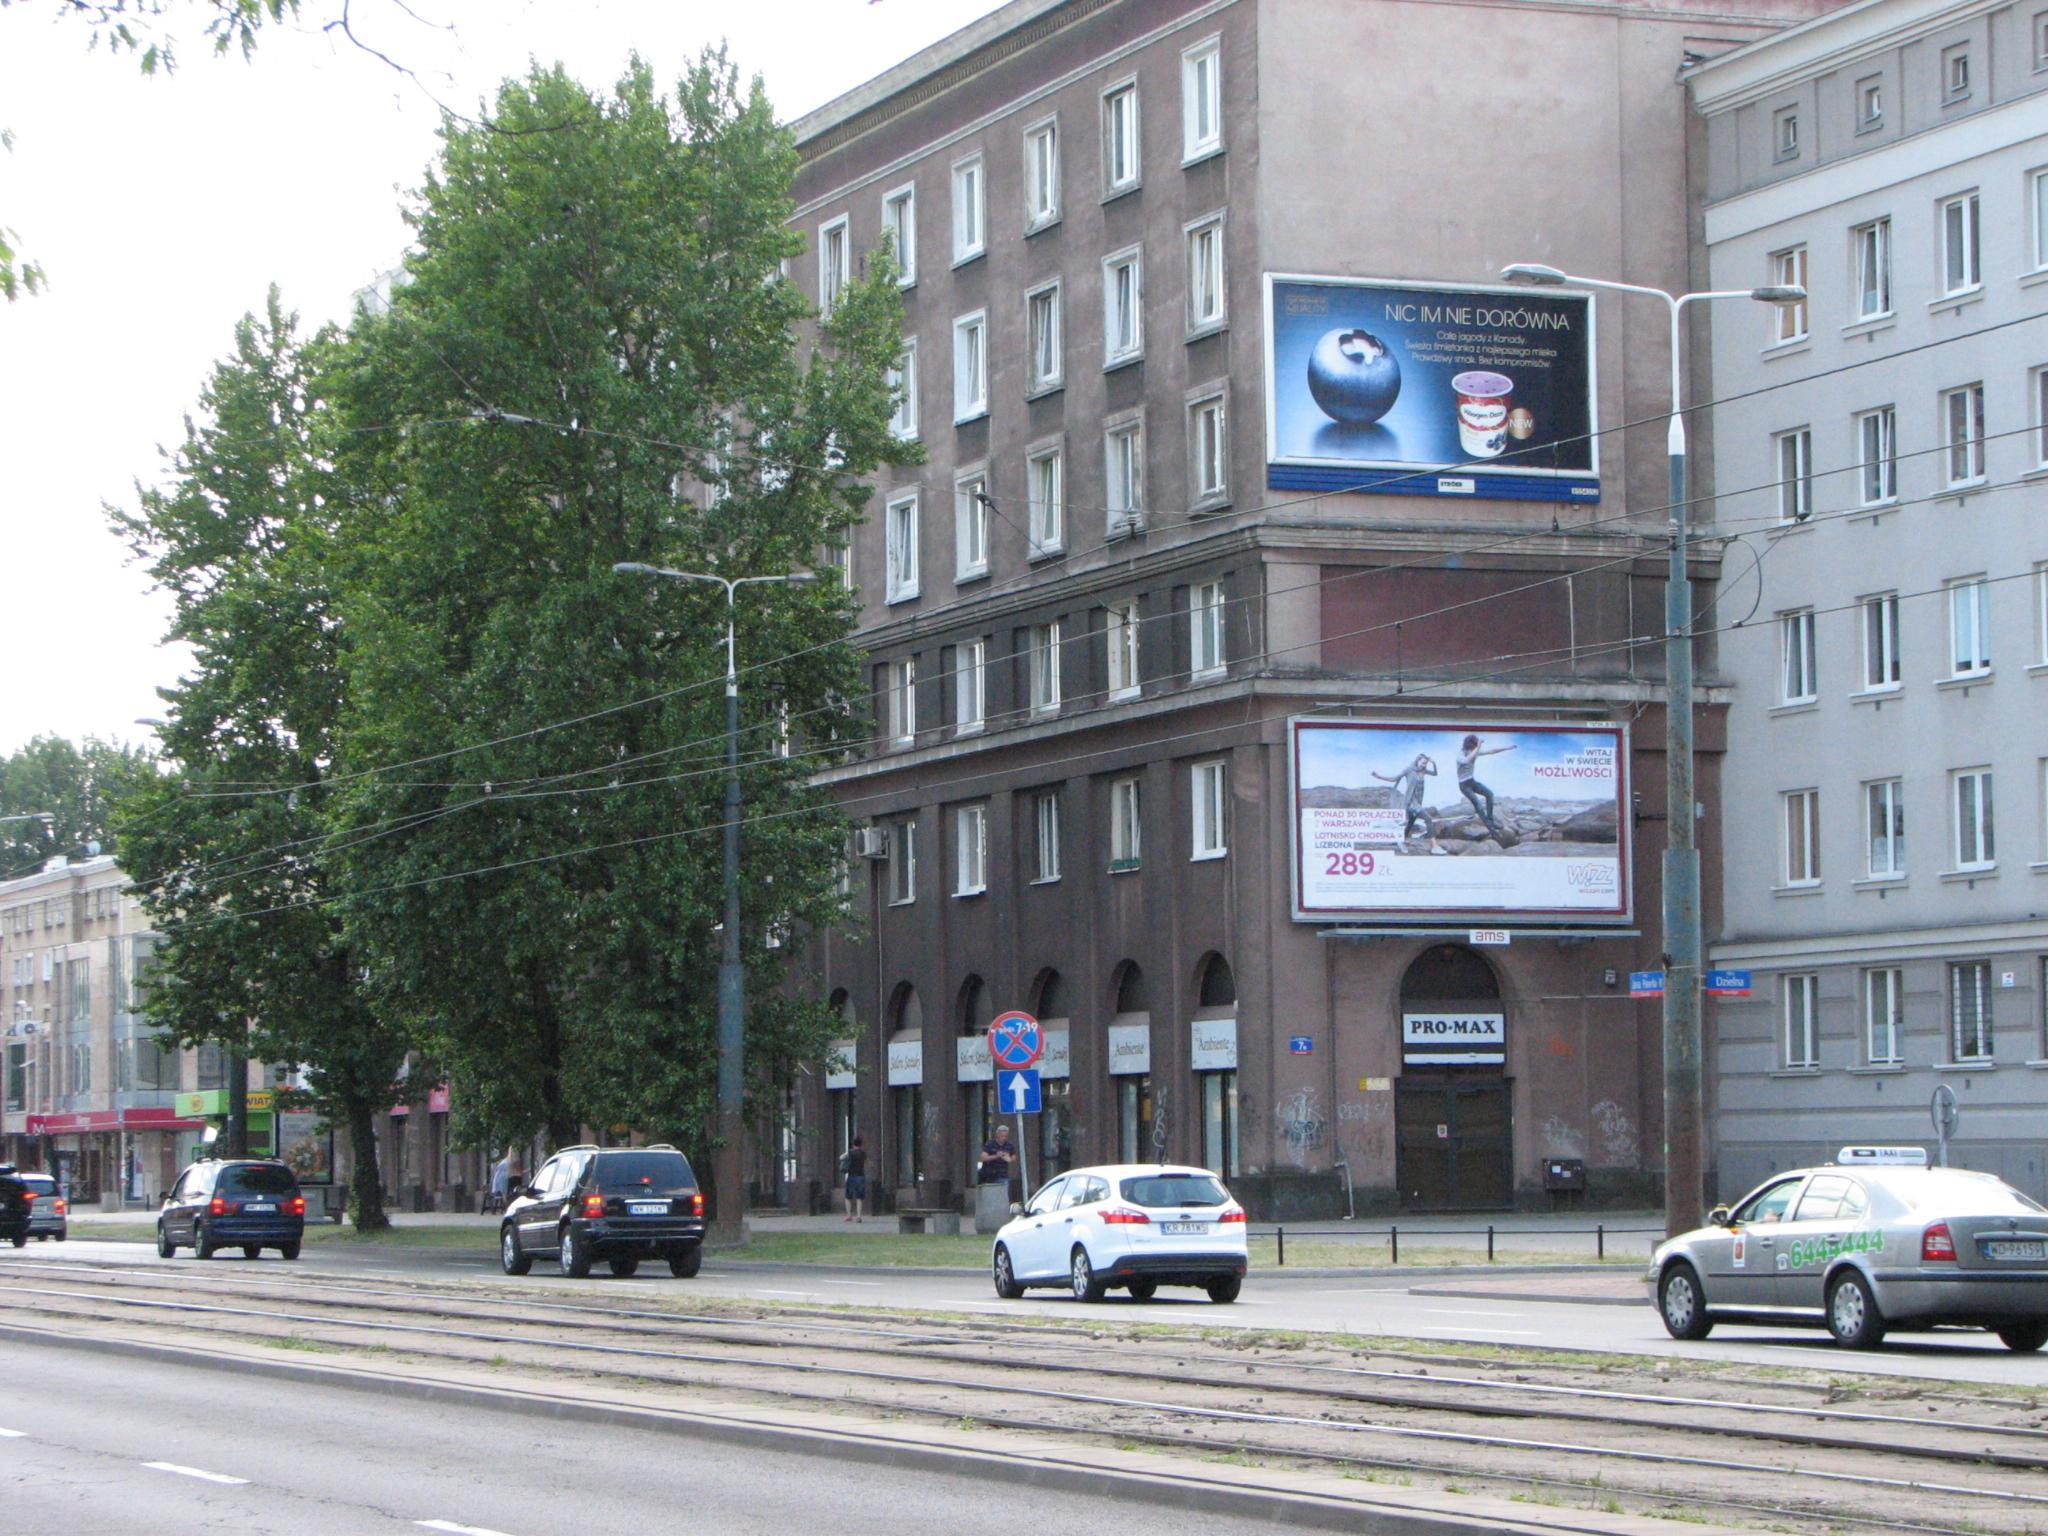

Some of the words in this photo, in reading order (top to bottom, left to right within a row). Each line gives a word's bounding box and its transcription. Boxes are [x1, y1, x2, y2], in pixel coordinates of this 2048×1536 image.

[1385, 304, 1415, 322] NIC
[1421, 306, 1441, 324] IM
[1446, 307, 1471, 325] NIE
[1476, 308, 1570, 330] DORÓWNA
[1585, 748, 1612, 757] WITAJ
[1566, 757, 1575, 765] W
[1314, 810, 1344, 818] PONAD
[1322, 820, 1370, 828] WARSZAWY
[1315, 841, 1352, 849] LIZBONA
[1325, 852, 1374, 876] 289
[1475, 931, 1505, 942] ams
[1716, 976, 1744, 987] Dzielna
[1015, 1022, 1038, 1034] 7-19
[1411, 1020, 1496, 1034] PRO-MAX
[1879, 1149, 1898, 1157] TAXI
